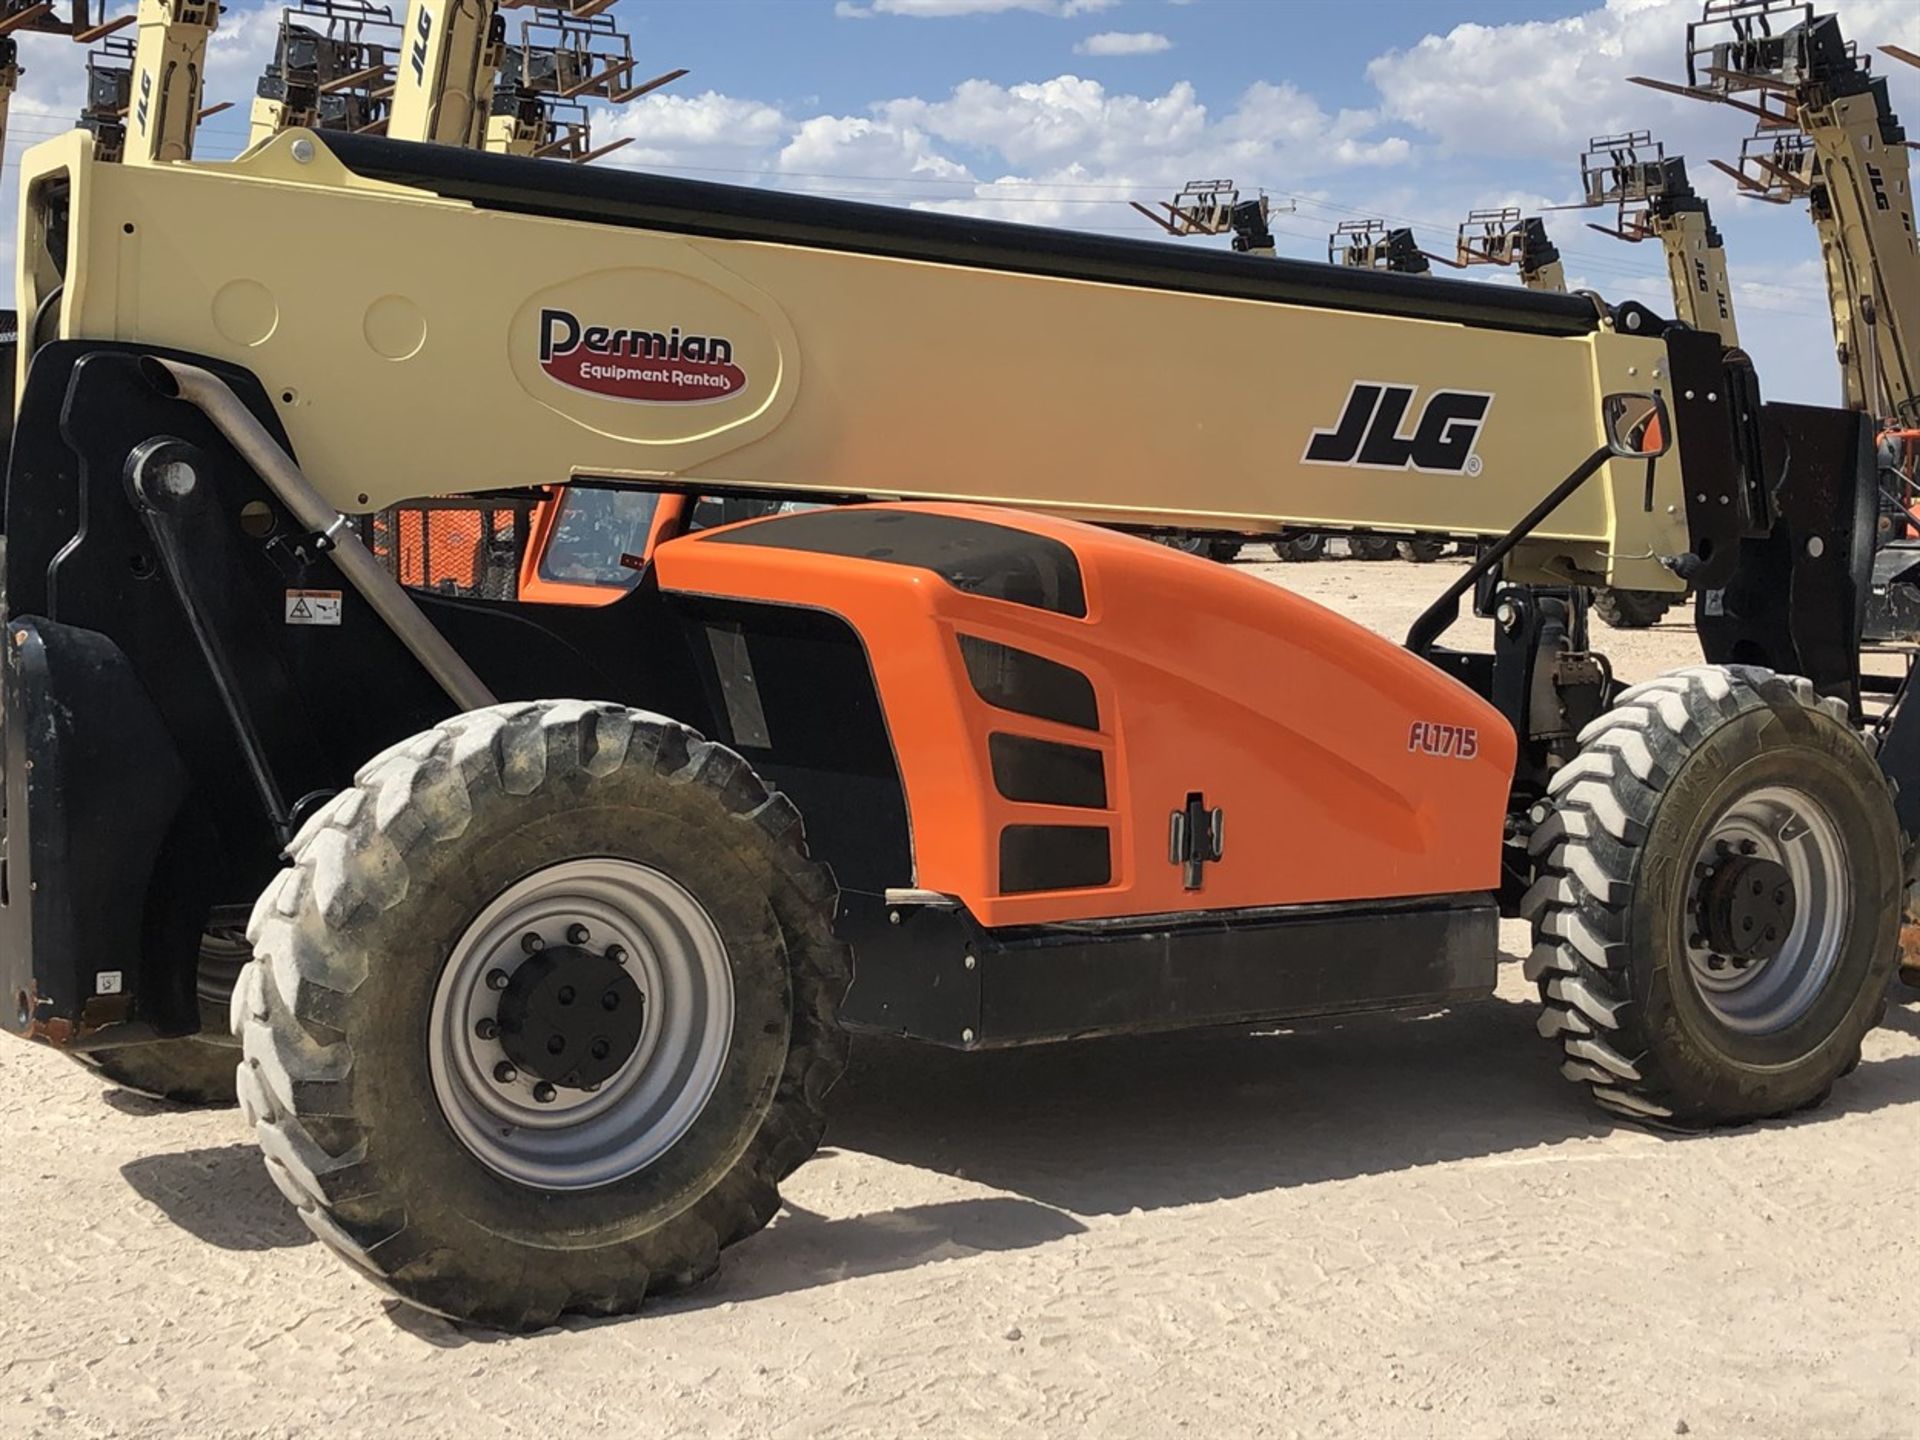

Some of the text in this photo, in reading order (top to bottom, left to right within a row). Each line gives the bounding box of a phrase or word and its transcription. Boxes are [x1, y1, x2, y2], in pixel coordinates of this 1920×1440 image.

[411, 4, 432, 88] JLG
[137, 68, 151, 137] JLG
[1865, 162, 1889, 210] JLG
[1695, 258, 1709, 292] JLG
[539, 309, 733, 365] Permian
[579, 362, 731, 390] Equipment Rentals
[1303, 383, 1492, 471] JLG
[1408, 721, 1478, 758] FL1715
